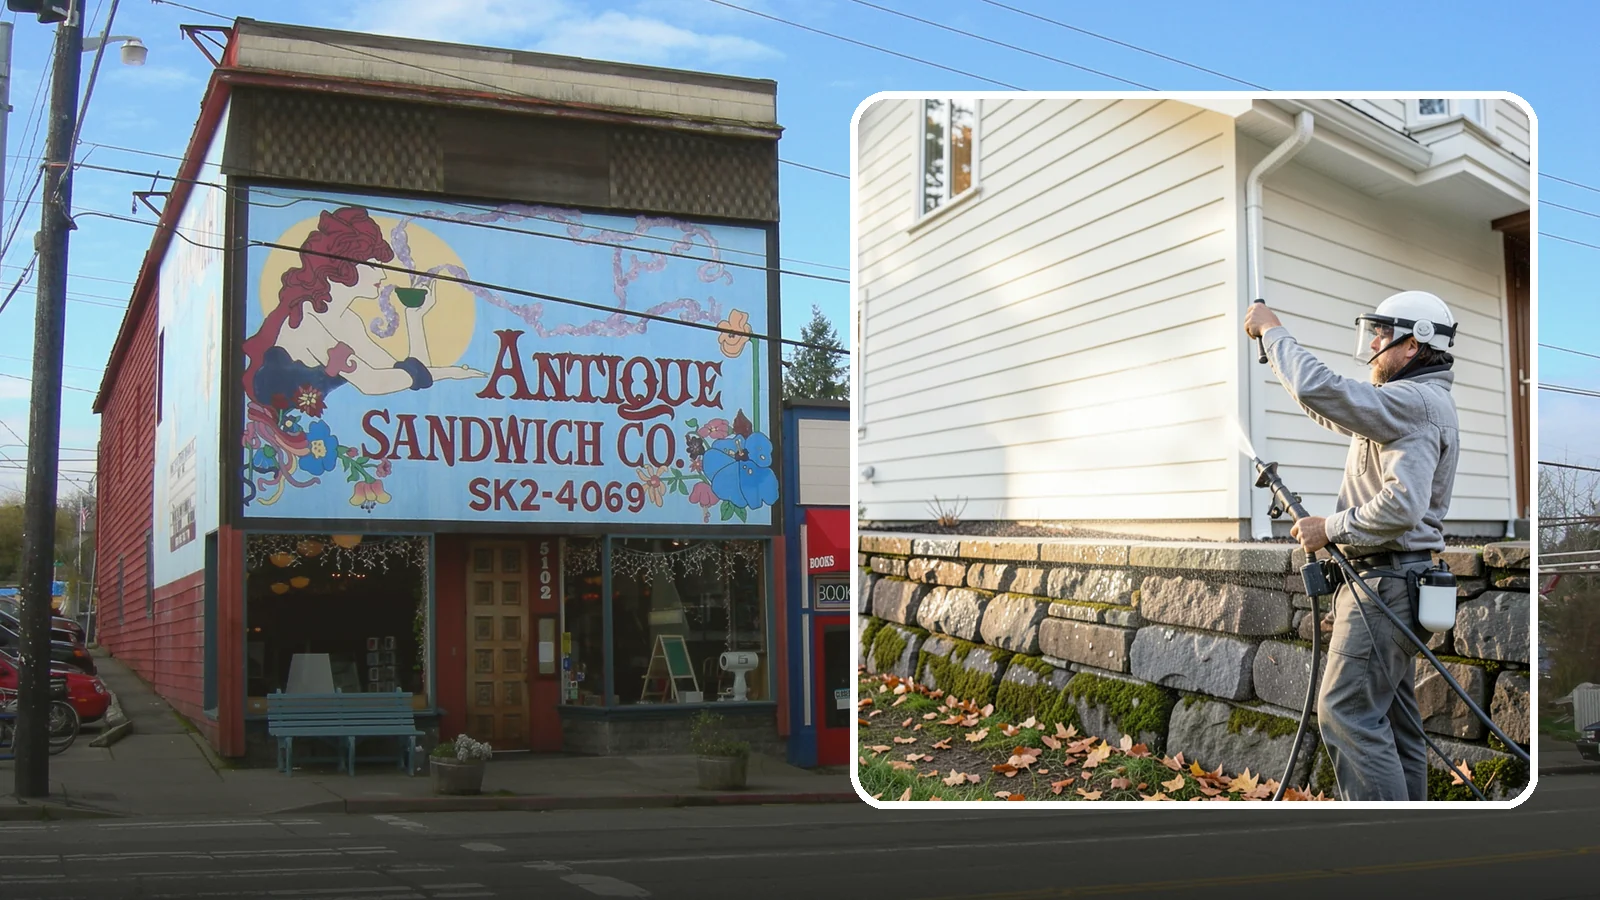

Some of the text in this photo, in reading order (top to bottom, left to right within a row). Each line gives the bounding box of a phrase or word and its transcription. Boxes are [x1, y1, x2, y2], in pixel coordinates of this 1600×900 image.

[475, 329, 723, 420] ANTIQUE
[361, 408, 685, 468] SANDWICH CO.
[469, 477, 645, 513] SK2-4069
[540, 543, 552, 598] 5102
[809, 555, 834, 569] BOOKS
